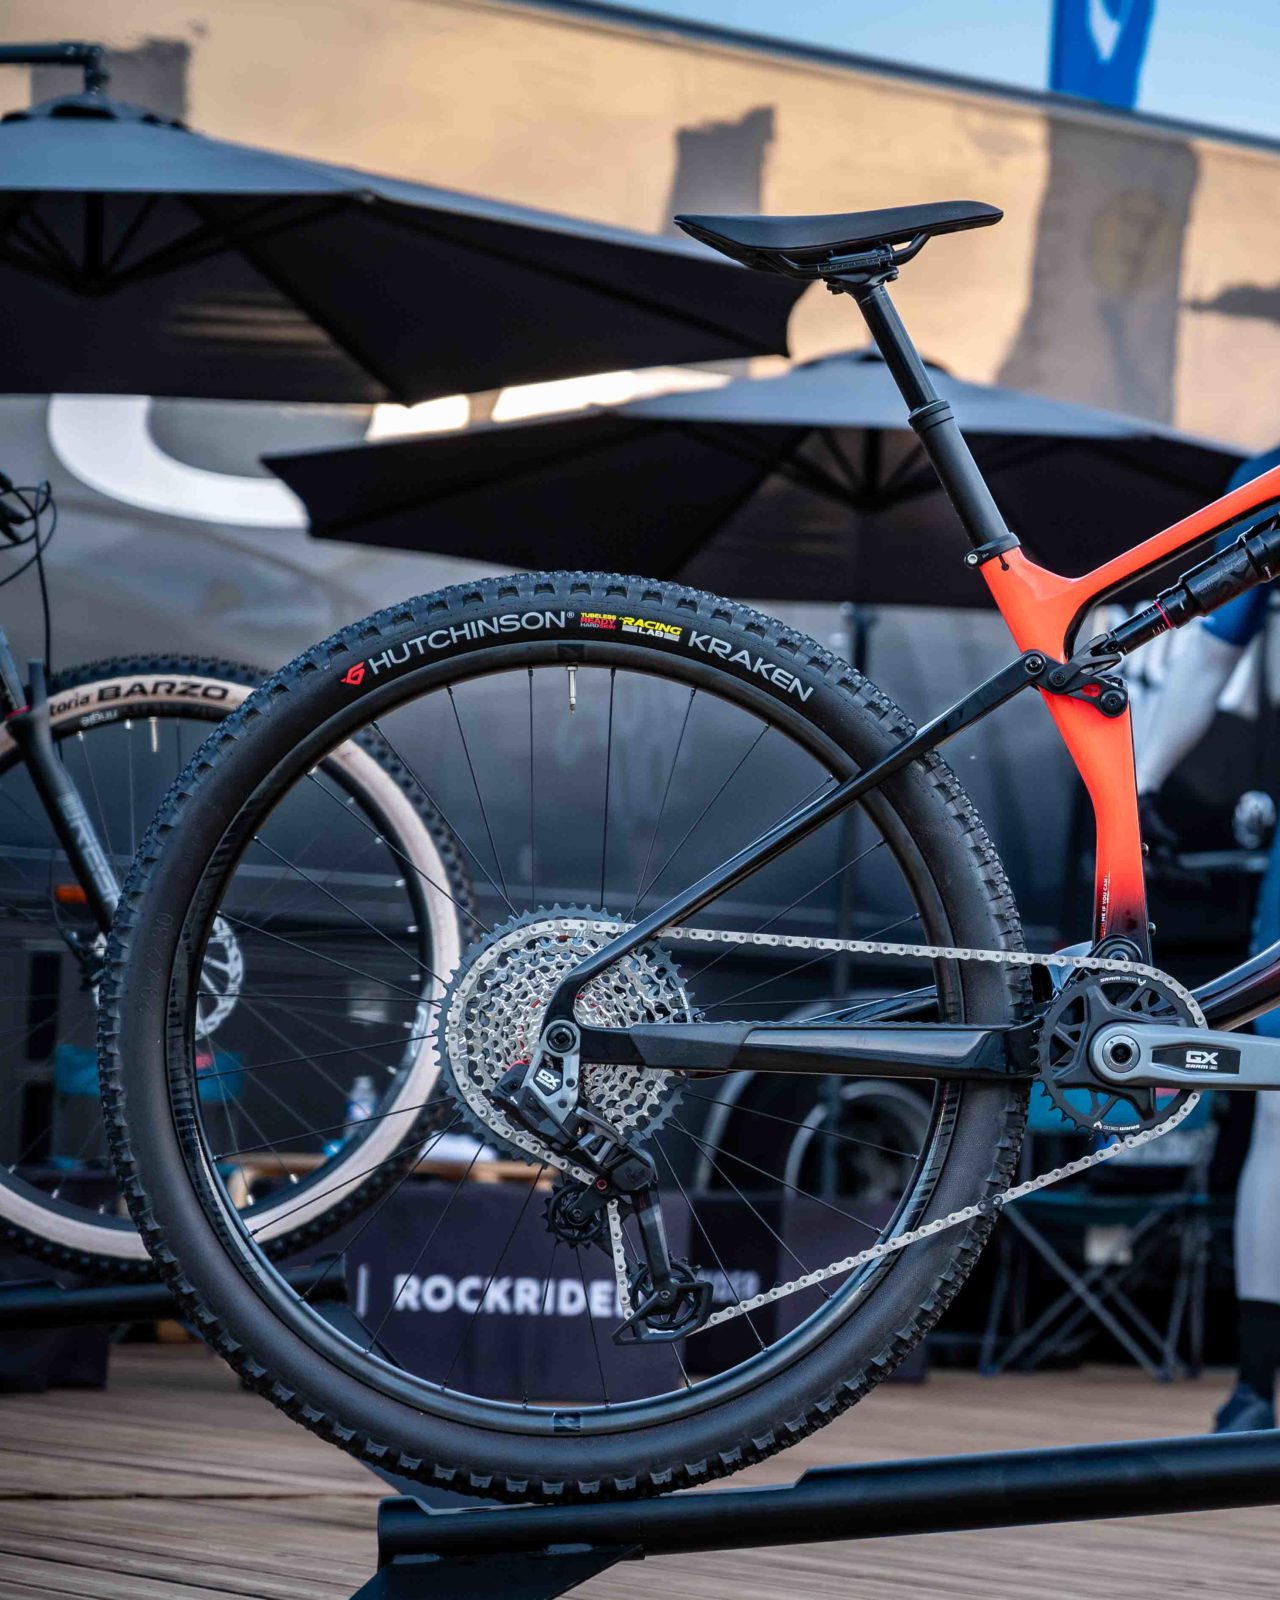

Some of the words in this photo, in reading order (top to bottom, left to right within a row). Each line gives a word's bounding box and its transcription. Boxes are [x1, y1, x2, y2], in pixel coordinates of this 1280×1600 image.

[622, 617, 682, 635] RACING
[638, 627, 664, 638] LAB
[688, 630, 814, 702] KRAKEN
[50, 692, 89, 717] toria
[98, 681, 229, 702] BARZO
[1185, 1050, 1219, 1064] GX
[393, 1273, 626, 1317] ROCKRIDE
